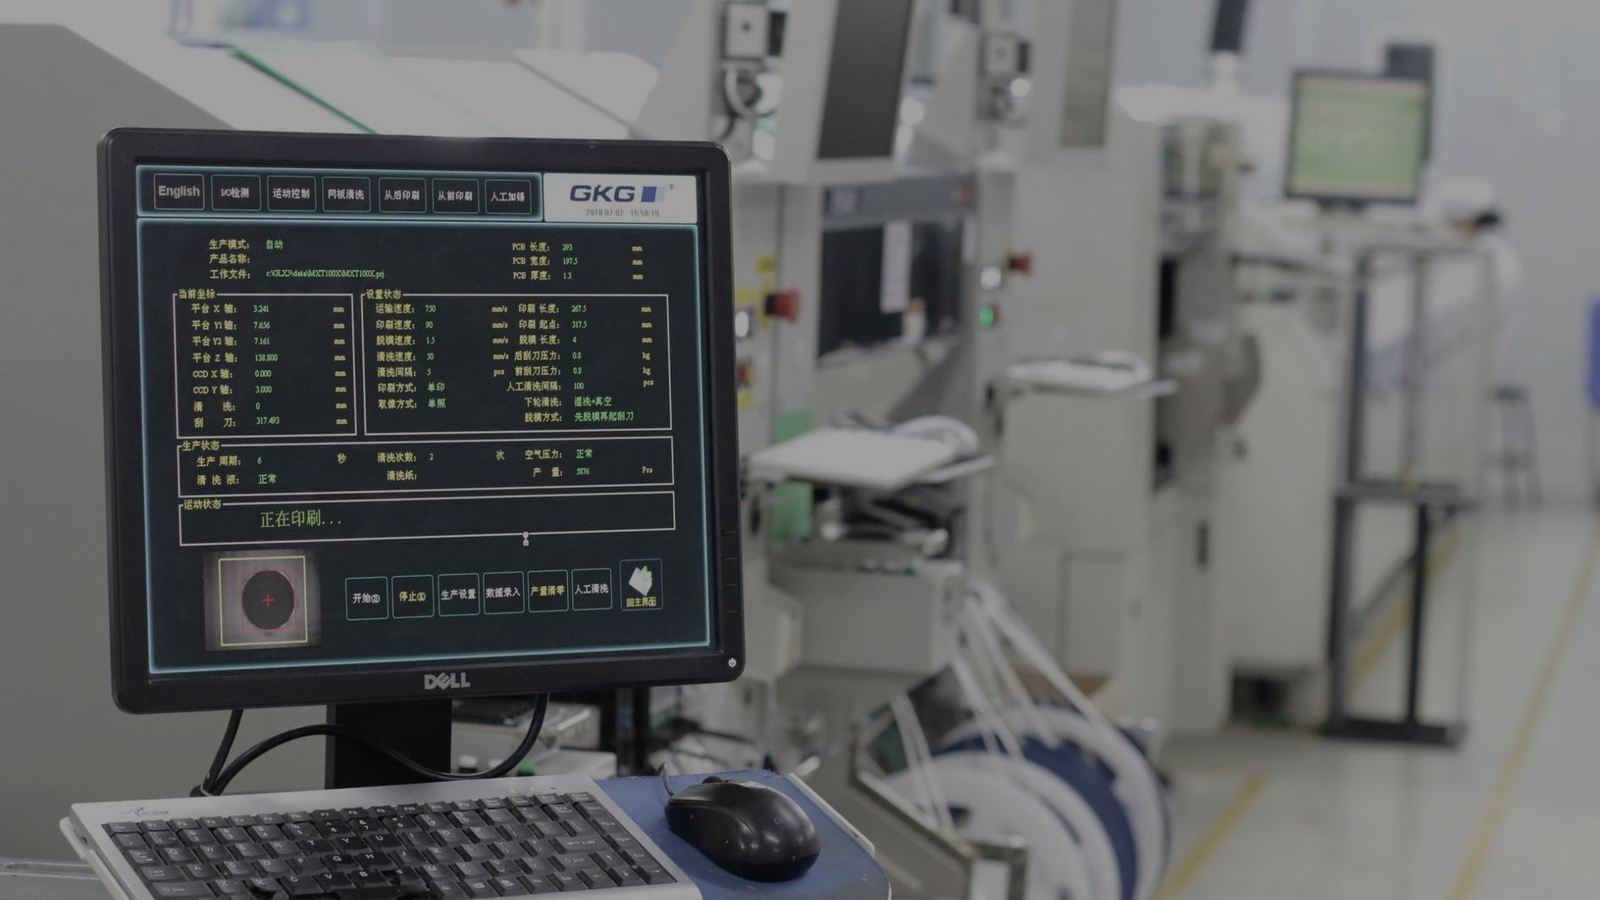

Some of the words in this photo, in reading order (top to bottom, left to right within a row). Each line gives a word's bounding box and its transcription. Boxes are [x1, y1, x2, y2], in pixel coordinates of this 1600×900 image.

[159, 185, 200, 199] English
[273, 188, 309, 199] 运动控制
[569, 184, 636, 203] GKG
[267, 240, 283, 249] 自动
[178, 289, 216, 299] 当前坐标
[192, 303, 209, 313] 平台
[192, 320, 209, 330] 平台
[192, 336, 210, 346] 平台
[427, 336, 435, 344] 1.5
[193, 353, 211, 363] 平台
[193, 370, 208, 378] CCD
[427, 368, 431, 376] 5
[193, 386, 209, 394] CCD
[423, 672, 471, 691] DELL
